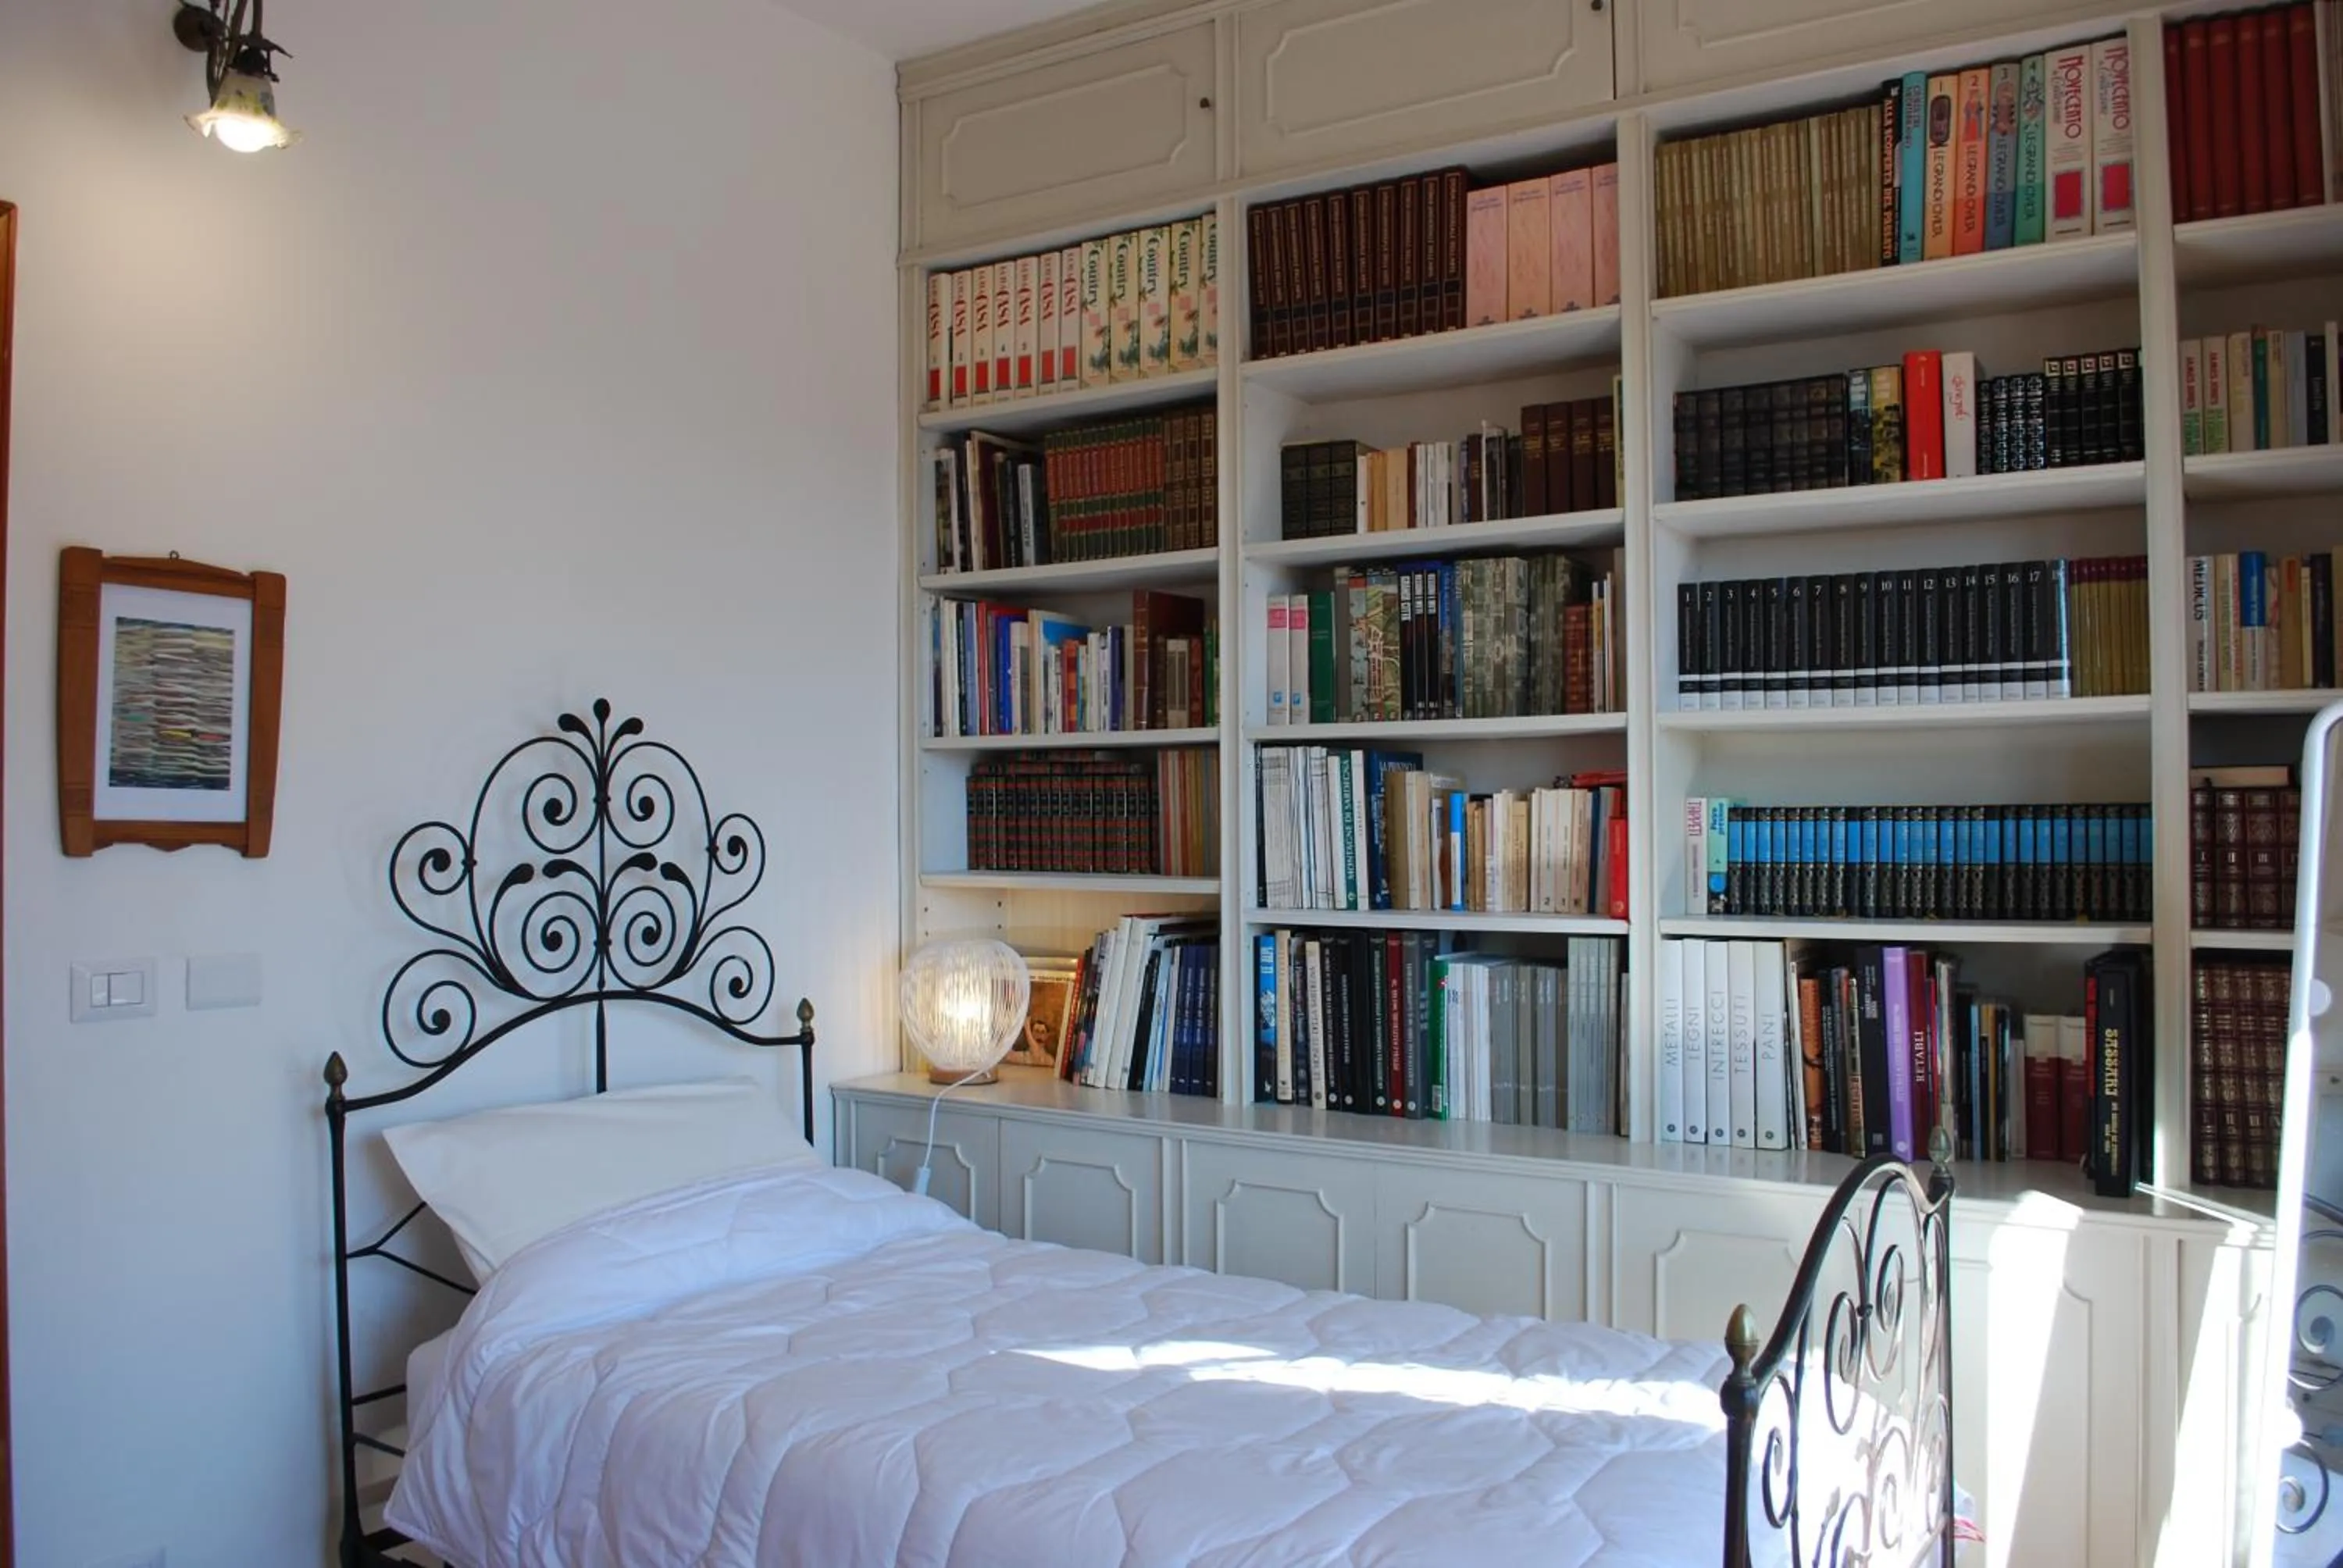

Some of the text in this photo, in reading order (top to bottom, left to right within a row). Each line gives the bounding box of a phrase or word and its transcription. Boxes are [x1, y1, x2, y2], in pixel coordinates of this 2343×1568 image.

[2058, 55, 2084, 139] NOVECENTO
[2105, 45, 2131, 130] NOVECENTO
[1883, 99, 1892, 259] ALLA SCOPERTA DEL PASSATO
[1931, 162, 1945, 202] GRANDI
[1966, 158, 1977, 198] GRANDI
[1086, 248, 1101, 308] Country
[1115, 243, 1129, 301] Country
[1146, 237, 1161, 298] Country
[1178, 230, 1193, 290] Country
[975, 294, 989, 333] CASA
[996, 290, 1010, 329] CASA
[1018, 287, 1032, 326] CASA
[1041, 282, 1055, 322] CASA
[1064, 277, 1078, 317] CASA
[929, 303, 941, 340] CASA
[954, 300, 968, 338] CASA
[2186, 356, 2196, 383] JAMES
[1881, 580, 1892, 591] 10
[1903, 579, 1912, 590] 11
[1923, 578, 1935, 590] 12
[1945, 577, 1956, 588] 13
[1965, 576, 1976, 586] 14
[1985, 574, 1995, 586] 15
[2006, 572, 2019, 584] 16
[2029, 570, 2041, 582] 17
[2193, 559, 2206, 622] MEDICUS
[1342, 759, 1352, 811] SARDEGNA
[1664, 998, 1678, 1067] METALLI
[1685, 1007, 1700, 1060] LEGNI
[1710, 990, 1725, 1080] INTRECCI
[1733, 995, 1748, 1074] TESSUTI
[1760, 1014, 1775, 1060] PANI
[1913, 1031, 1925, 1082] RETABLI
[2105, 1028, 2120, 1096] SASSARI
